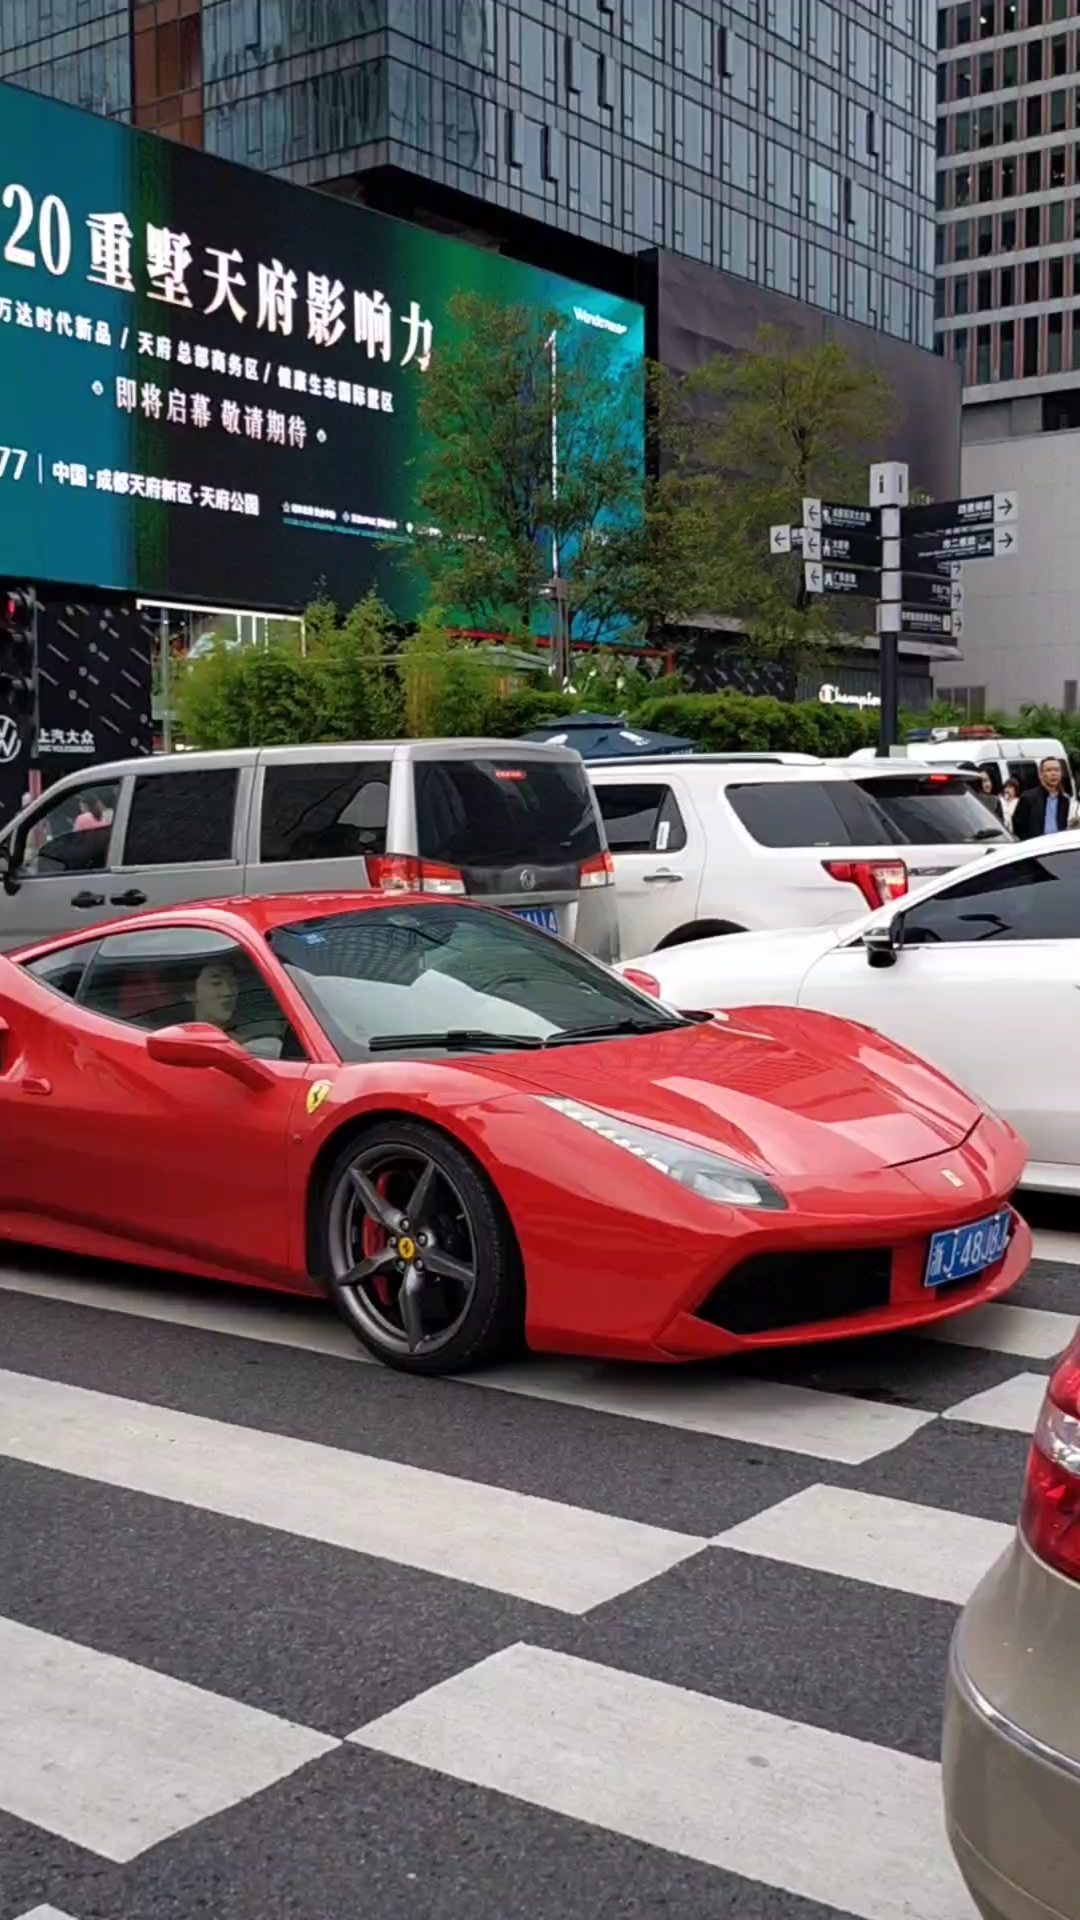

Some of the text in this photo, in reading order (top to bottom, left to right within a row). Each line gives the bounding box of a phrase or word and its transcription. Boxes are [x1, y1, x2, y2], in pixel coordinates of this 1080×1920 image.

[115, 376, 309, 449] 即将启幕 敬请期待
[38, 727, 95, 745] 上汽大众
